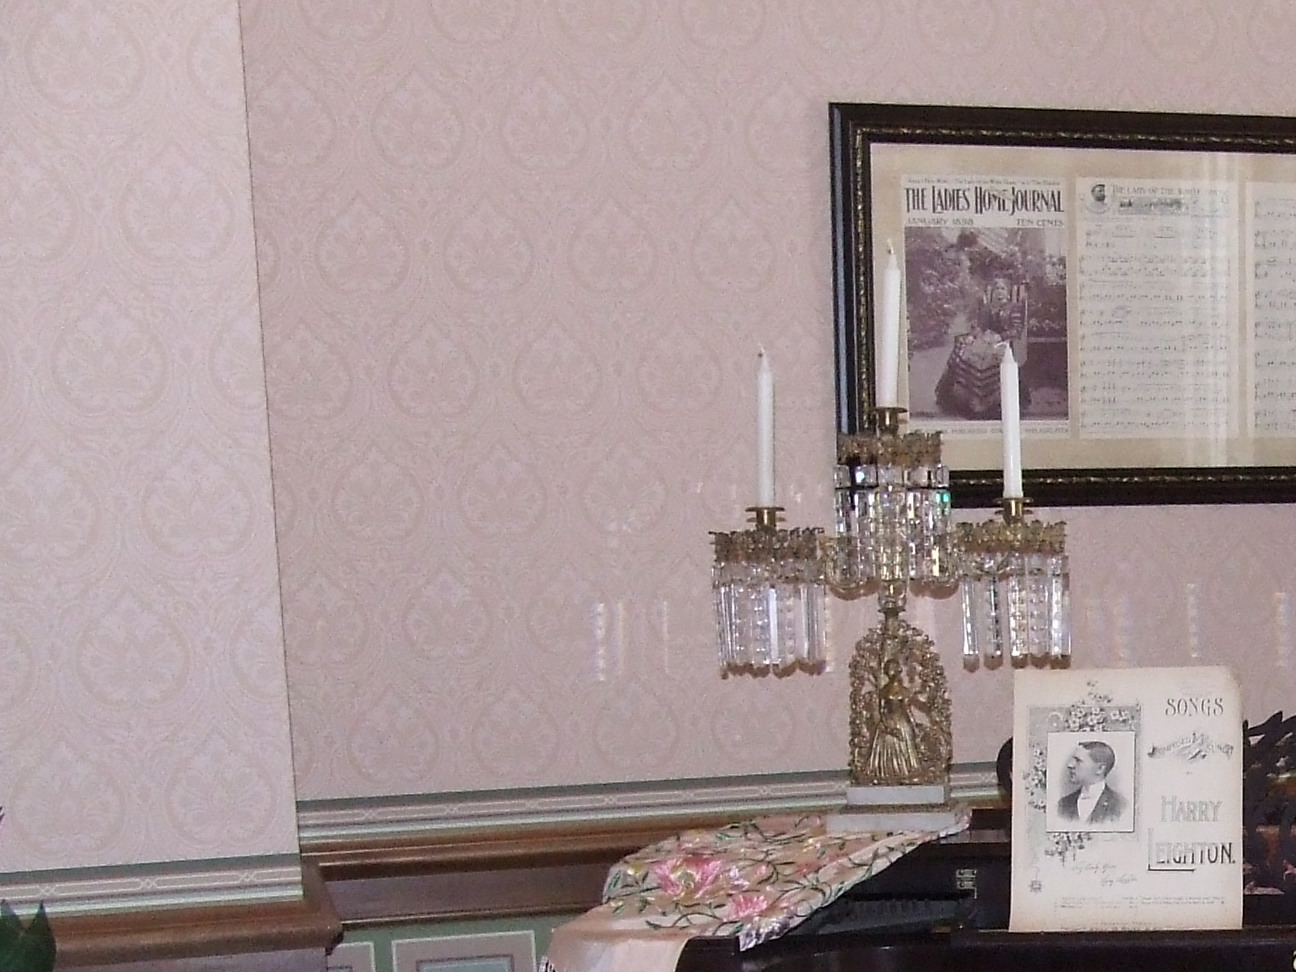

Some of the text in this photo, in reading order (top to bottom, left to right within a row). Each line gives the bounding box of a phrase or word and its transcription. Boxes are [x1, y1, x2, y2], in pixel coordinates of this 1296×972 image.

[904, 187, 927, 213] THE
[975, 186, 1009, 214] HOME
[1009, 186, 1065, 216] JOURNAL
[1165, 697, 1224, 717] SONGS
[1159, 795, 1223, 823] HARRY
